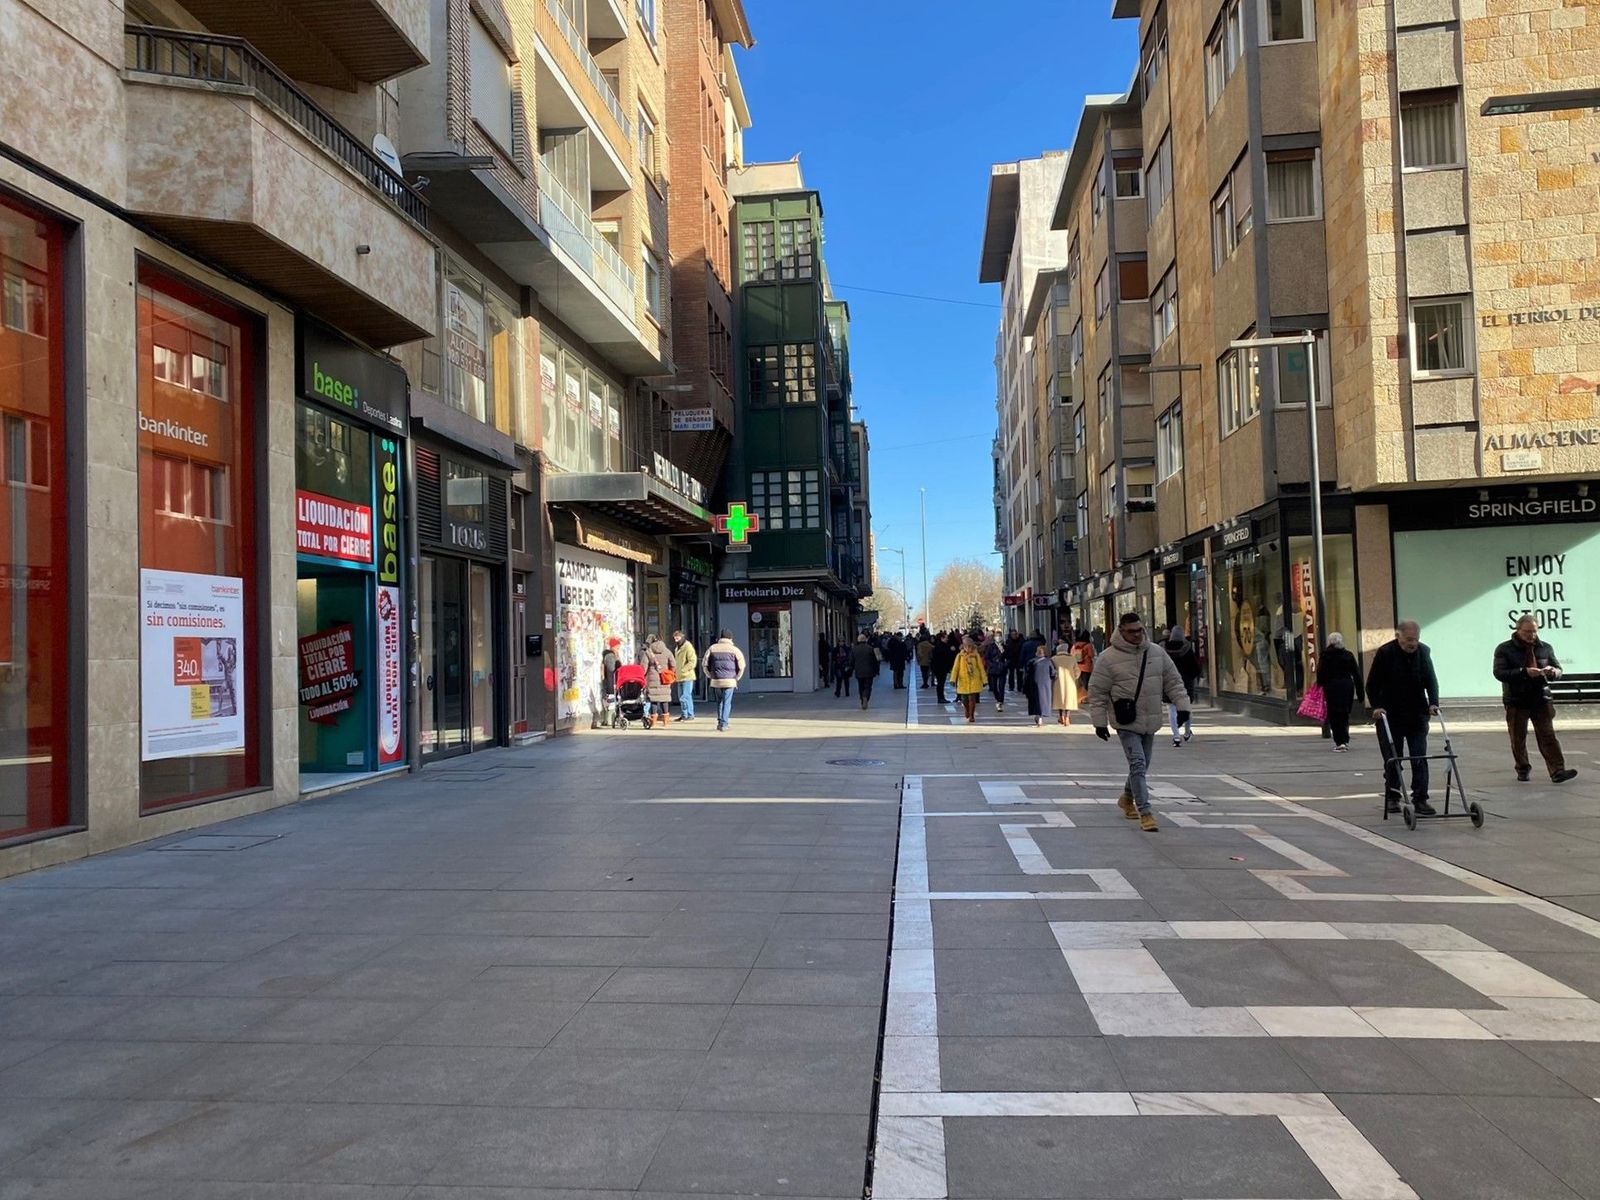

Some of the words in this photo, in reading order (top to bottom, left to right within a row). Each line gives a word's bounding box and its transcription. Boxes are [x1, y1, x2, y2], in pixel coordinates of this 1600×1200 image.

[1482, 314, 1501, 327] EL
[1507, 309, 1573, 326] FERROL
[1484, 429, 1600, 451] ALMACENE
[298, 497, 369, 535] LIQUIDACIÓN
[1469, 499, 1597, 518] SPRINGFIELD
[297, 530, 321, 550] TOTAL
[323, 534, 339, 552] POR
[340, 534, 371, 558] CIERRE
[558, 557, 598, 584] ZAMORA
[1506, 554, 1567, 577] ENJOY
[560, 584, 583, 605] LIBRE
[585, 588, 595, 607] DE
[725, 586, 780, 598] Herbolario
[782, 585, 805, 596] Diez
[1512, 581, 1566, 603] YOUR
[146, 611, 164, 627] sin
[167, 613, 226, 628] comisiones.
[1508, 608, 1572, 630] SORE
[301, 630, 352, 654] LIQUIDACIÓN
[304, 650, 329, 666] TOTAL
[329, 644, 346, 660] POR
[176, 659, 198, 677] 340
[306, 656, 348, 681] CIERRE
[300, 683, 321, 702] TODO
[321, 680, 333, 697] AL
[332, 672, 359, 693] 50%
